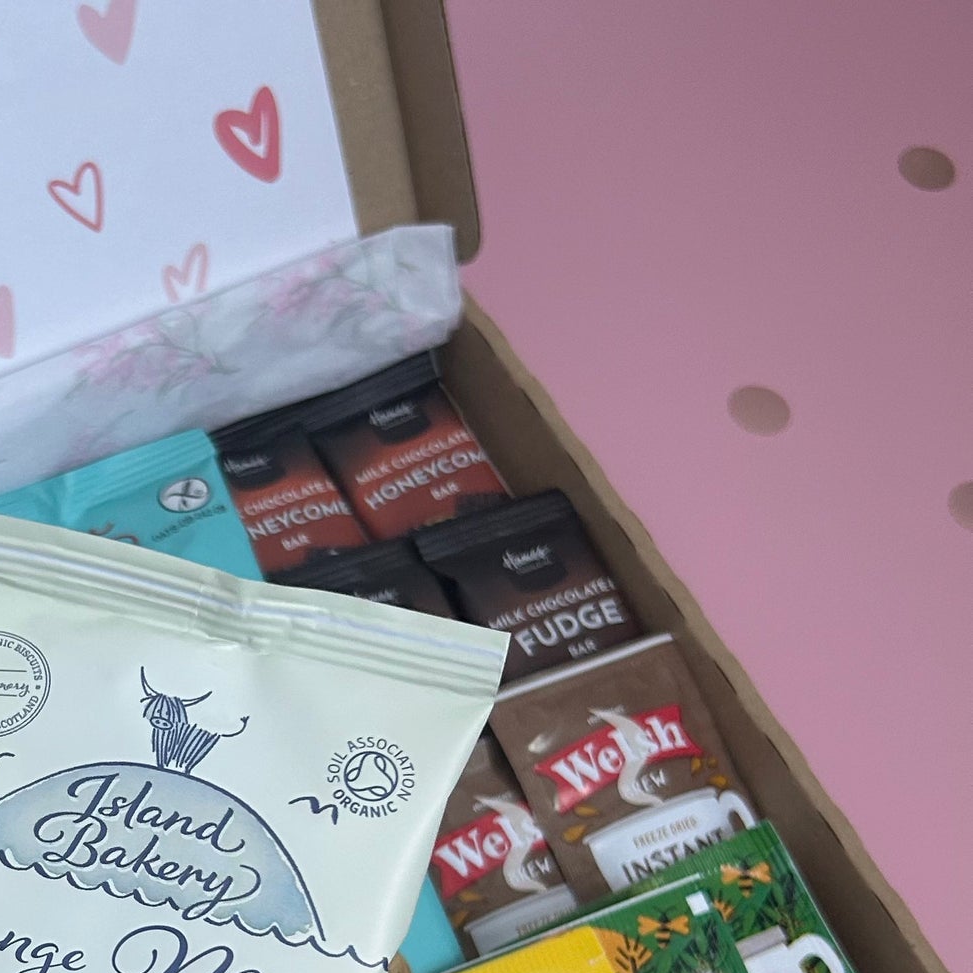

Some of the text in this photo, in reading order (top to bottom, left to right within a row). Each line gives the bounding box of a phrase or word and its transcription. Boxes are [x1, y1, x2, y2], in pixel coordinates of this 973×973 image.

[355, 465, 392, 487] MILK
[364, 450, 487, 511] HONEYCOM
[430, 482, 460, 501] BAR
[246, 501, 353, 541] NEYCOM
[282, 534, 311, 552] BAR
[488, 608, 527, 630] MILK
[514, 599, 626, 657] FUDGE
[14, 643, 43, 681] BISCUITS
[567, 639, 597, 659] BAR
[326, 752, 348, 783] SOIL
[347, 736, 416, 802] ASSOCIATION
[550, 713, 689, 795] Welsh
[66, 775, 246, 854] Island
[332, 789, 398, 818] ORGANIC
[33, 810, 262, 919] Bakery
[434, 812, 545, 879] Wels
[621, 827, 724, 884] INSTANT
